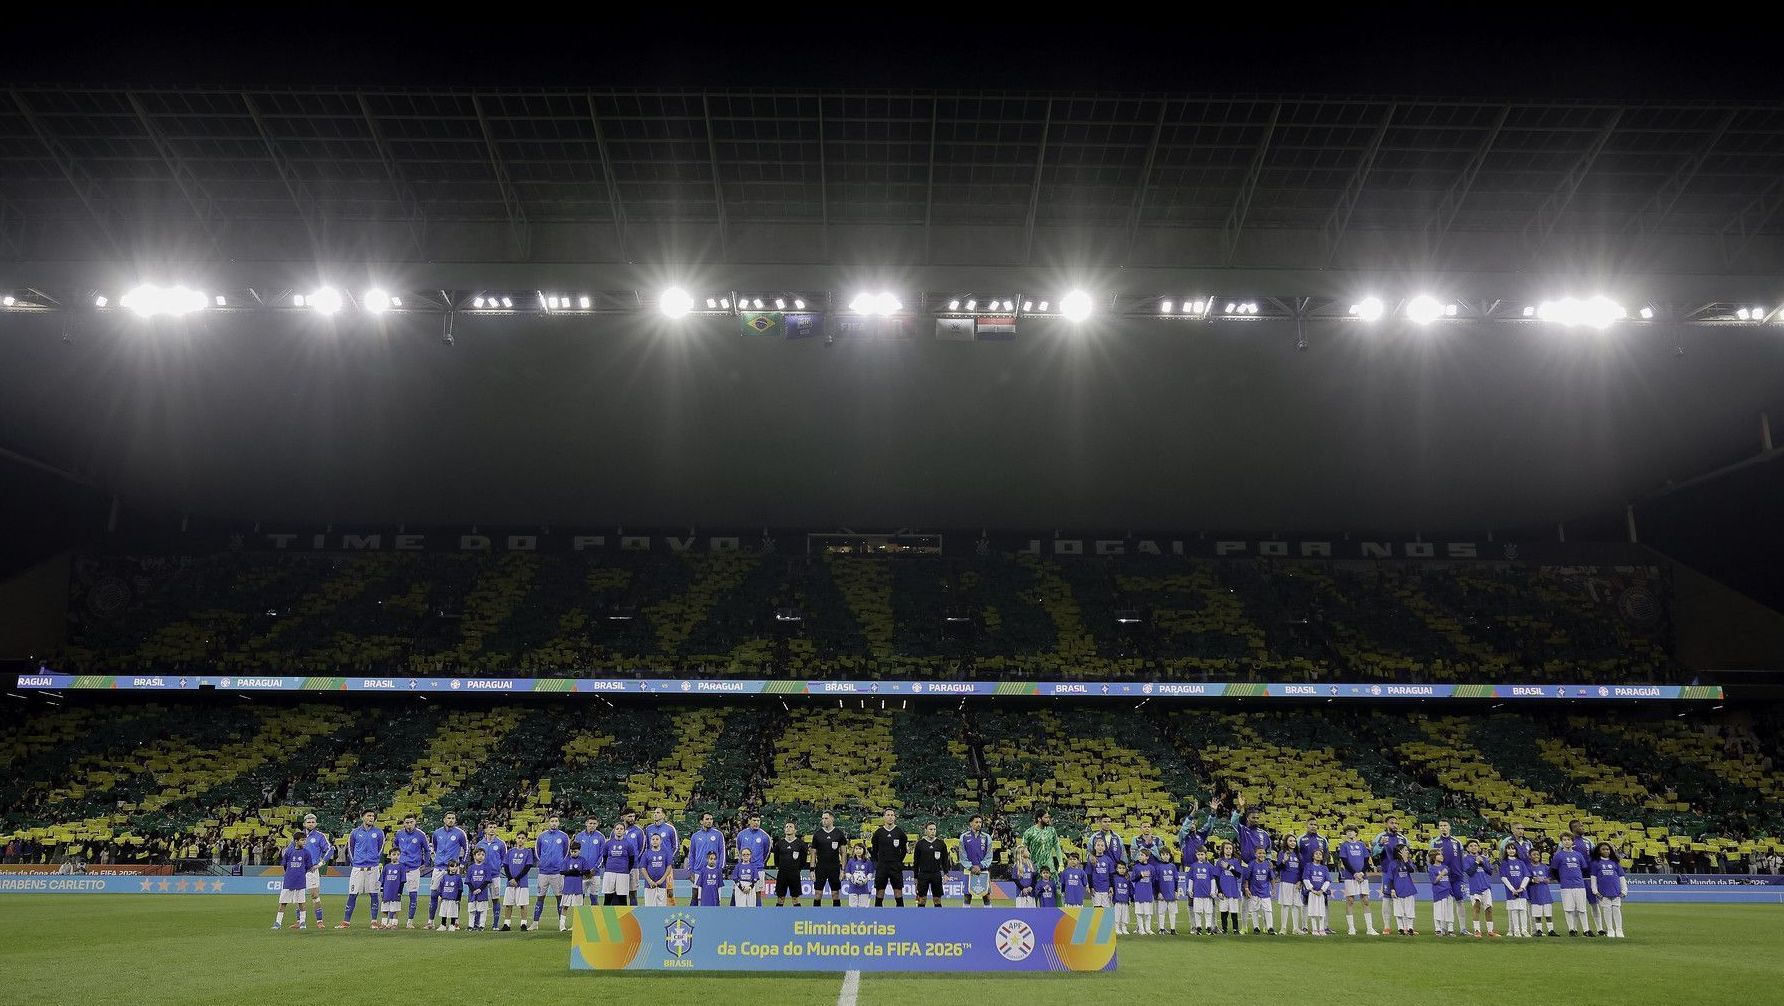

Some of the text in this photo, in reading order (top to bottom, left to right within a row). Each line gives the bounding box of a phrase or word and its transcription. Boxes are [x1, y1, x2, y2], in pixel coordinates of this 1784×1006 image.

[266, 534, 740, 551] TIME DO POVO
[1016, 539, 1184, 555] JOGAI
[1216, 541, 1332, 556] POR
[133, 678, 165, 686] BRASIL
[237, 679, 282, 687] PARAGUAI
[363, 680, 395, 688] BRASIL
[467, 681, 513, 689] PARAGUAI
[593, 681, 625, 689] BRASIL
[697, 682, 743, 690] PARAGUAI
[824, 683, 856, 691] BRASIL
[928, 684, 974, 692] PARAGUAI
[1055, 684, 1087, 693] BRASIL
[1159, 685, 1204, 693] PARAGUAI
[1285, 686, 1316, 694] BRASIL
[1387, 686, 1433, 695] PARAGUAI
[1512, 687, 1544, 695] BRASIL
[1615, 688, 1660, 696] PARAGUAI
[0, 878, 105, 890] RABÉNS CARLETTO
[267, 881, 284, 890] CB
[794, 920, 896, 935] Eliminatórias
[717, 941, 737, 956] da
[740, 941, 779, 958] Copa
[783, 941, 803, 956] do
[807, 941, 860, 957] Mundo
[863, 942, 883, 957] da
[887, 942, 922, 957] FIFA
[663, 959, 694, 968] BRASIL
